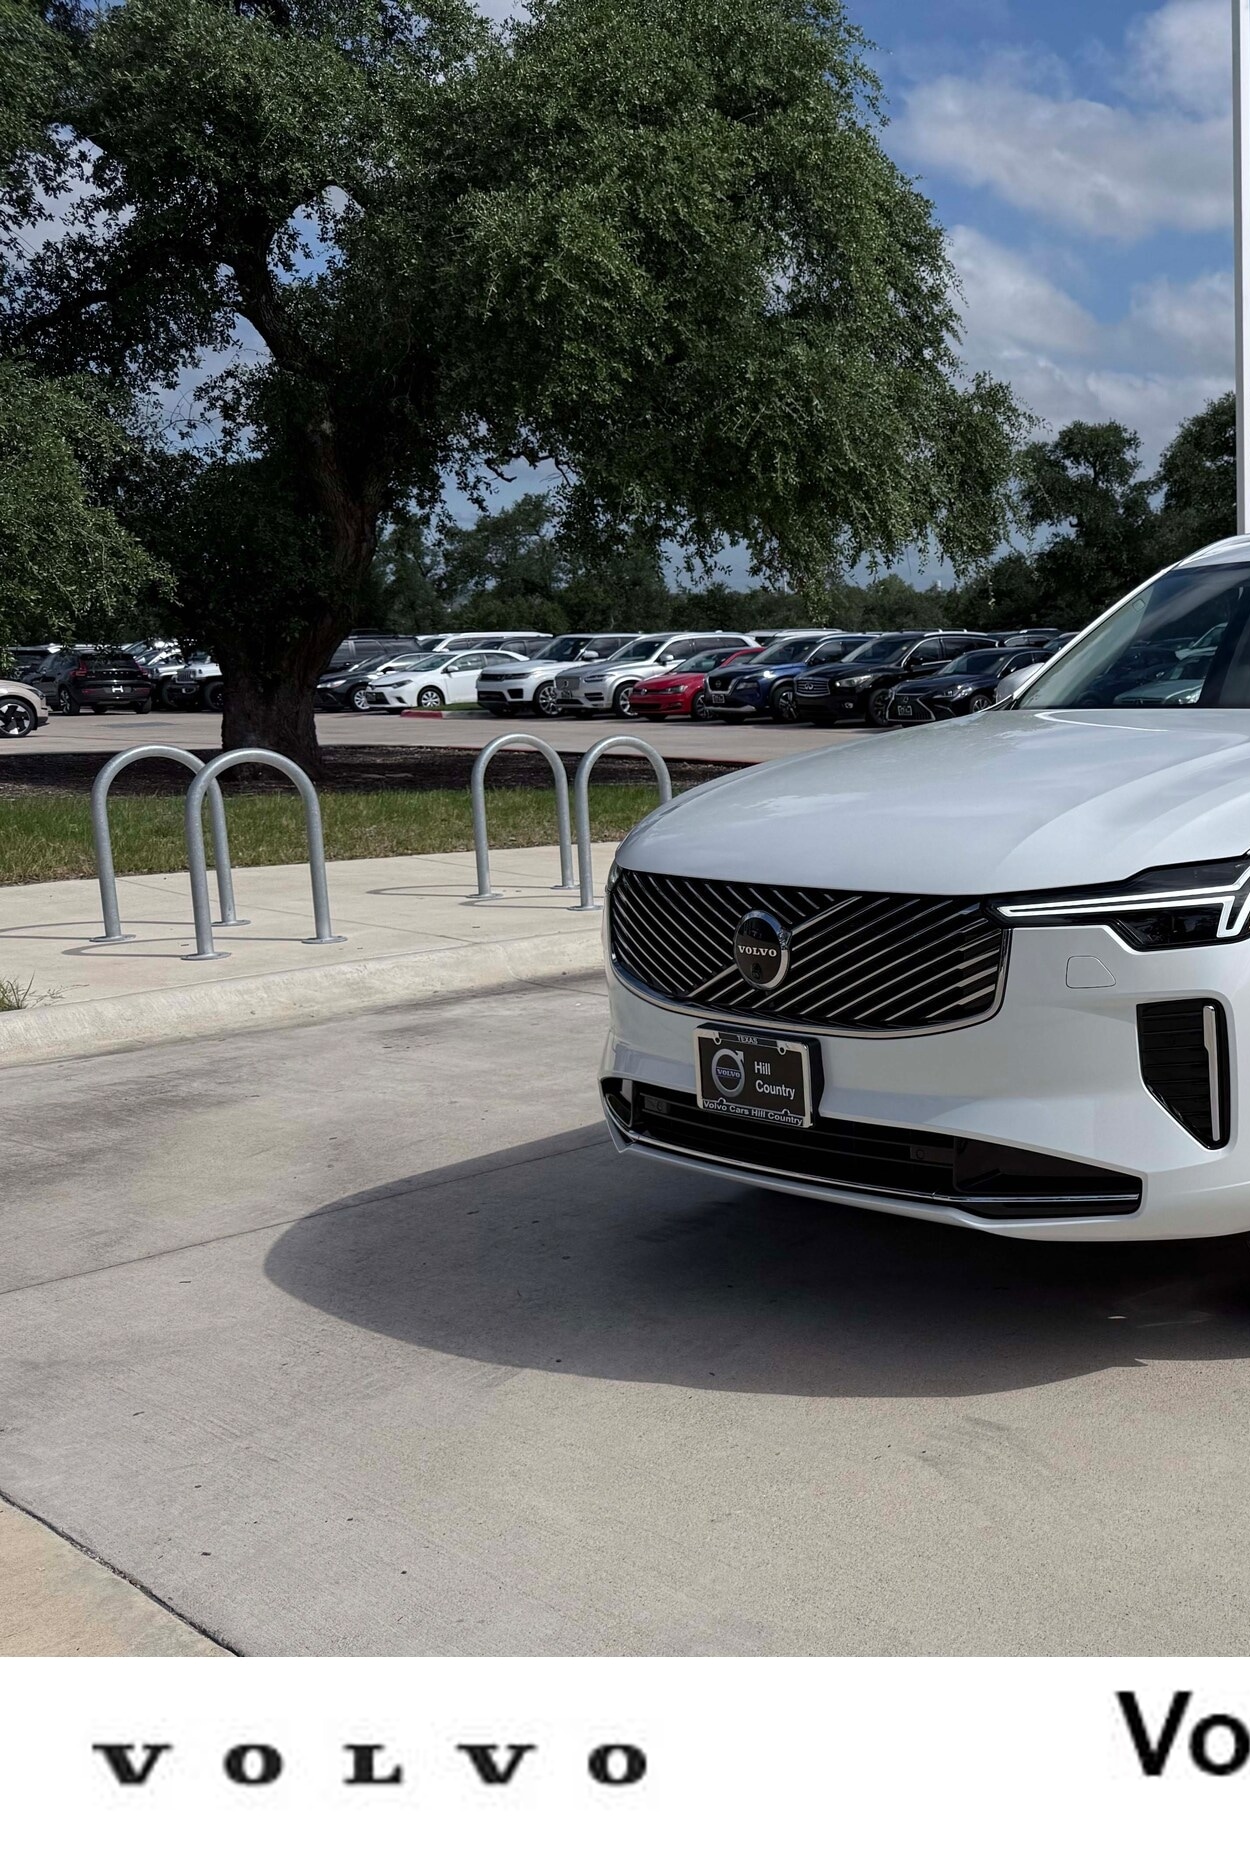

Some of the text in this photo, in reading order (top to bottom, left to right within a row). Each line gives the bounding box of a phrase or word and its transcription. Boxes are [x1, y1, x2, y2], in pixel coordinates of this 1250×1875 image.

[738, 945, 777, 957] VOLVO
[736, 1035, 759, 1045] TEXAS
[717, 1068, 741, 1078] VOLVO
[754, 1061, 771, 1075] Hill
[755, 1080, 795, 1100] Country
[703, 1100, 803, 1126] Volvo Cars Hill Country
